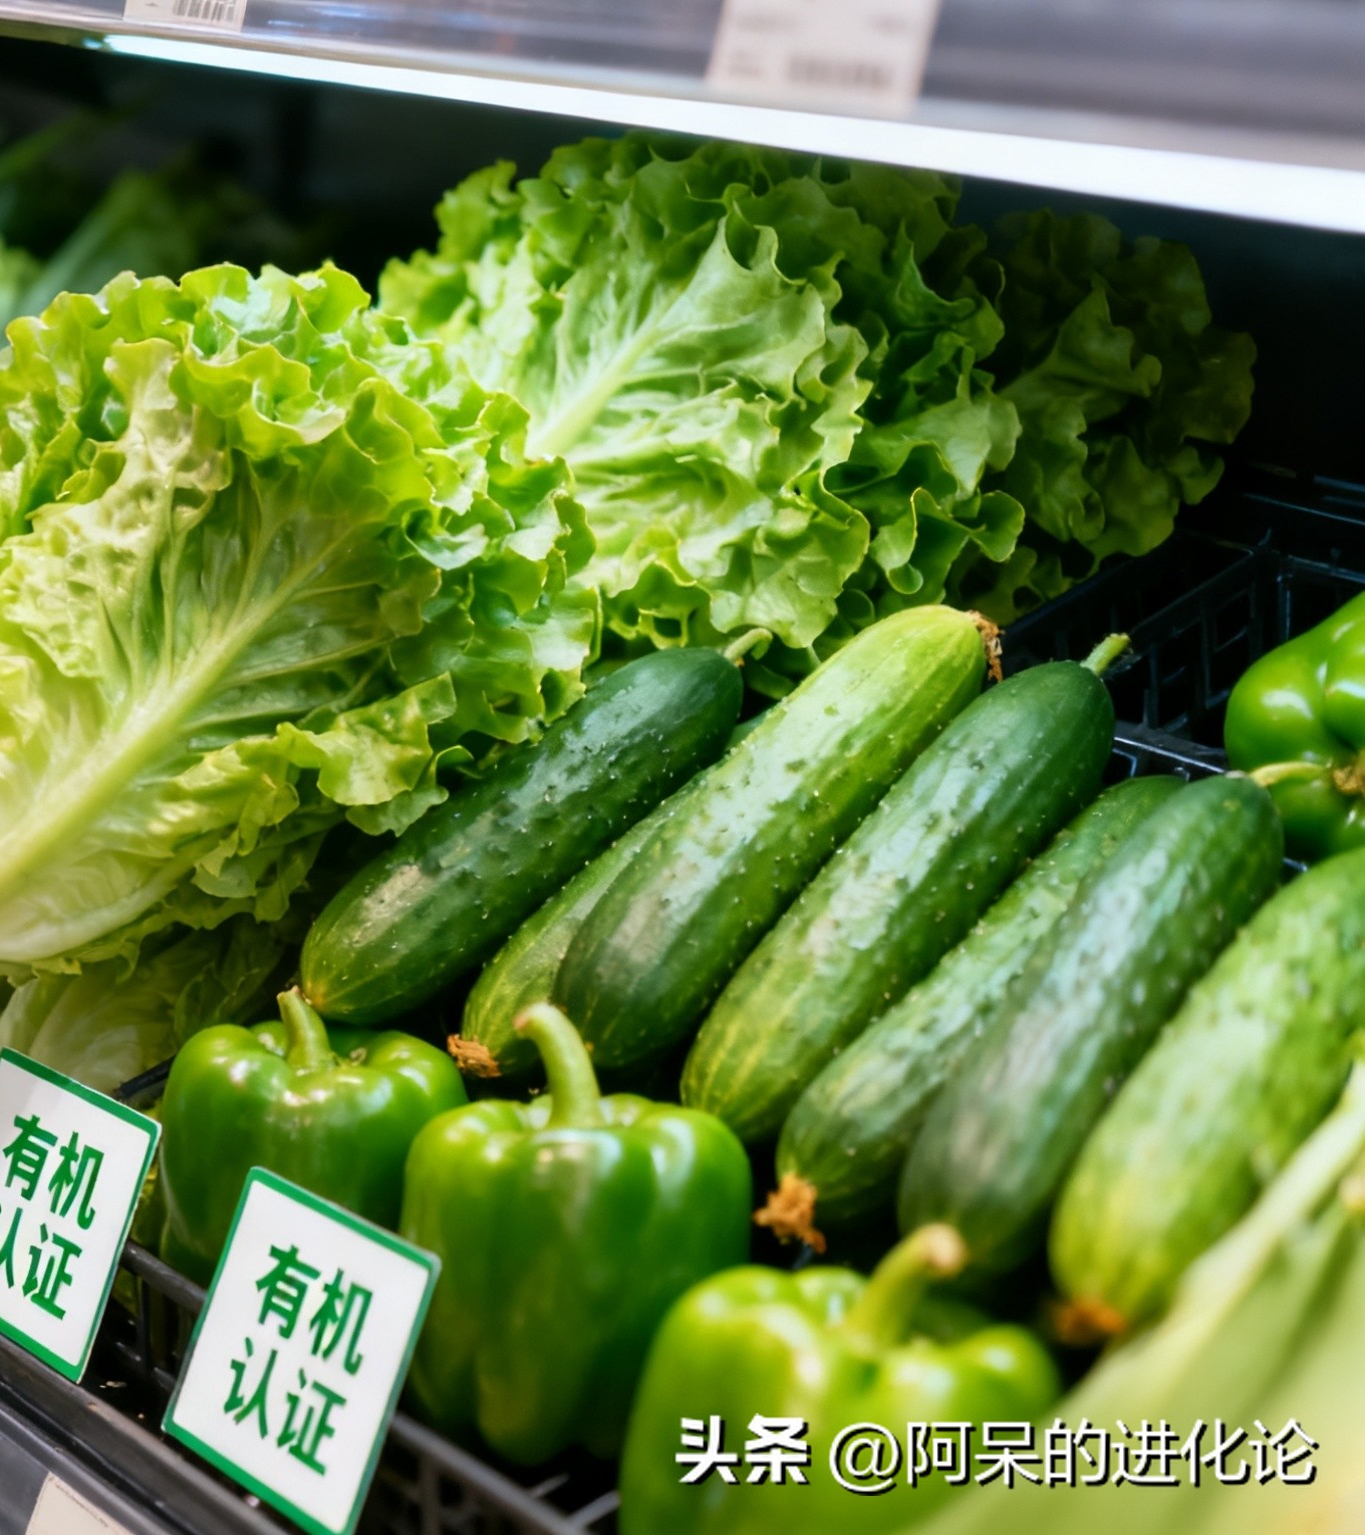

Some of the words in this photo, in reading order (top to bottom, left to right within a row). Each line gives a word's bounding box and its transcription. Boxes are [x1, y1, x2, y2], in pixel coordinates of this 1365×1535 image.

[1, 1113, 106, 1231] 有机
[254, 1243, 374, 1377] 有机
[221, 1335, 348, 1477] 认证
